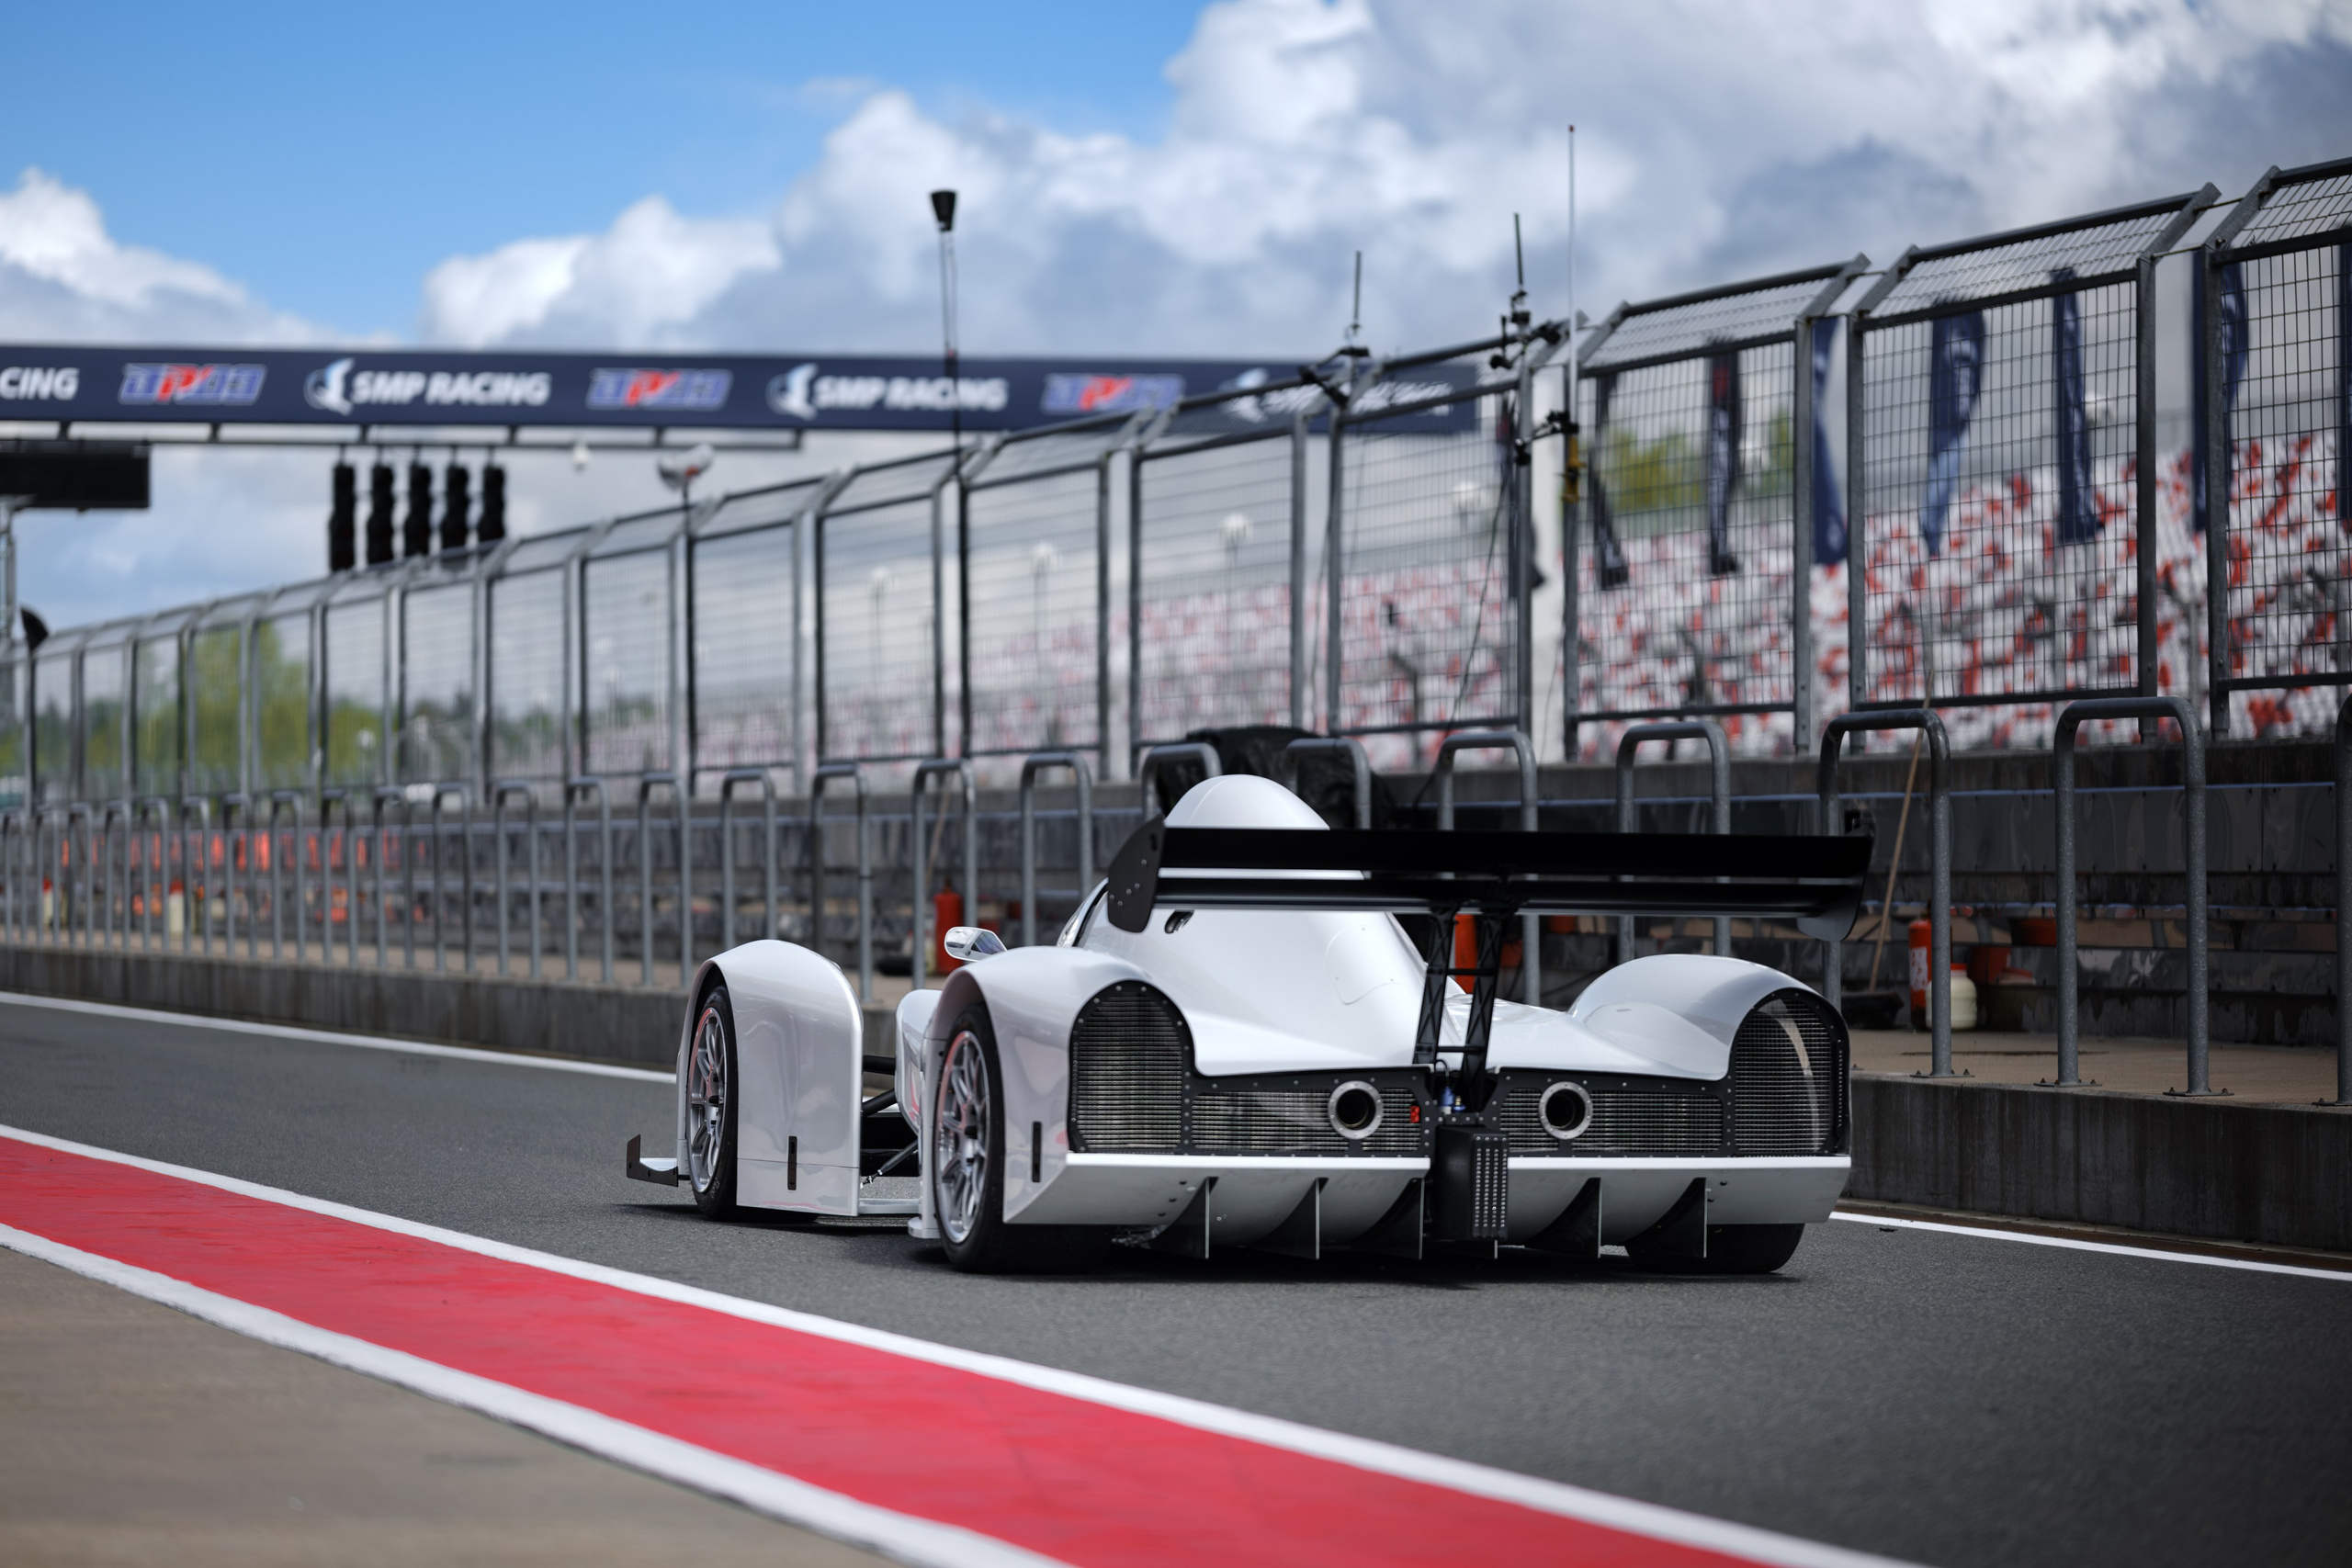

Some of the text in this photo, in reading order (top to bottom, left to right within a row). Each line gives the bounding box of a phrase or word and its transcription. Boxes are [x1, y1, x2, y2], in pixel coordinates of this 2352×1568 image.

[351, 371, 426, 404] SMP
[425, 372, 550, 406] RACING
[812, 376, 886, 410] SMP
[884, 377, 1008, 411] RACING
